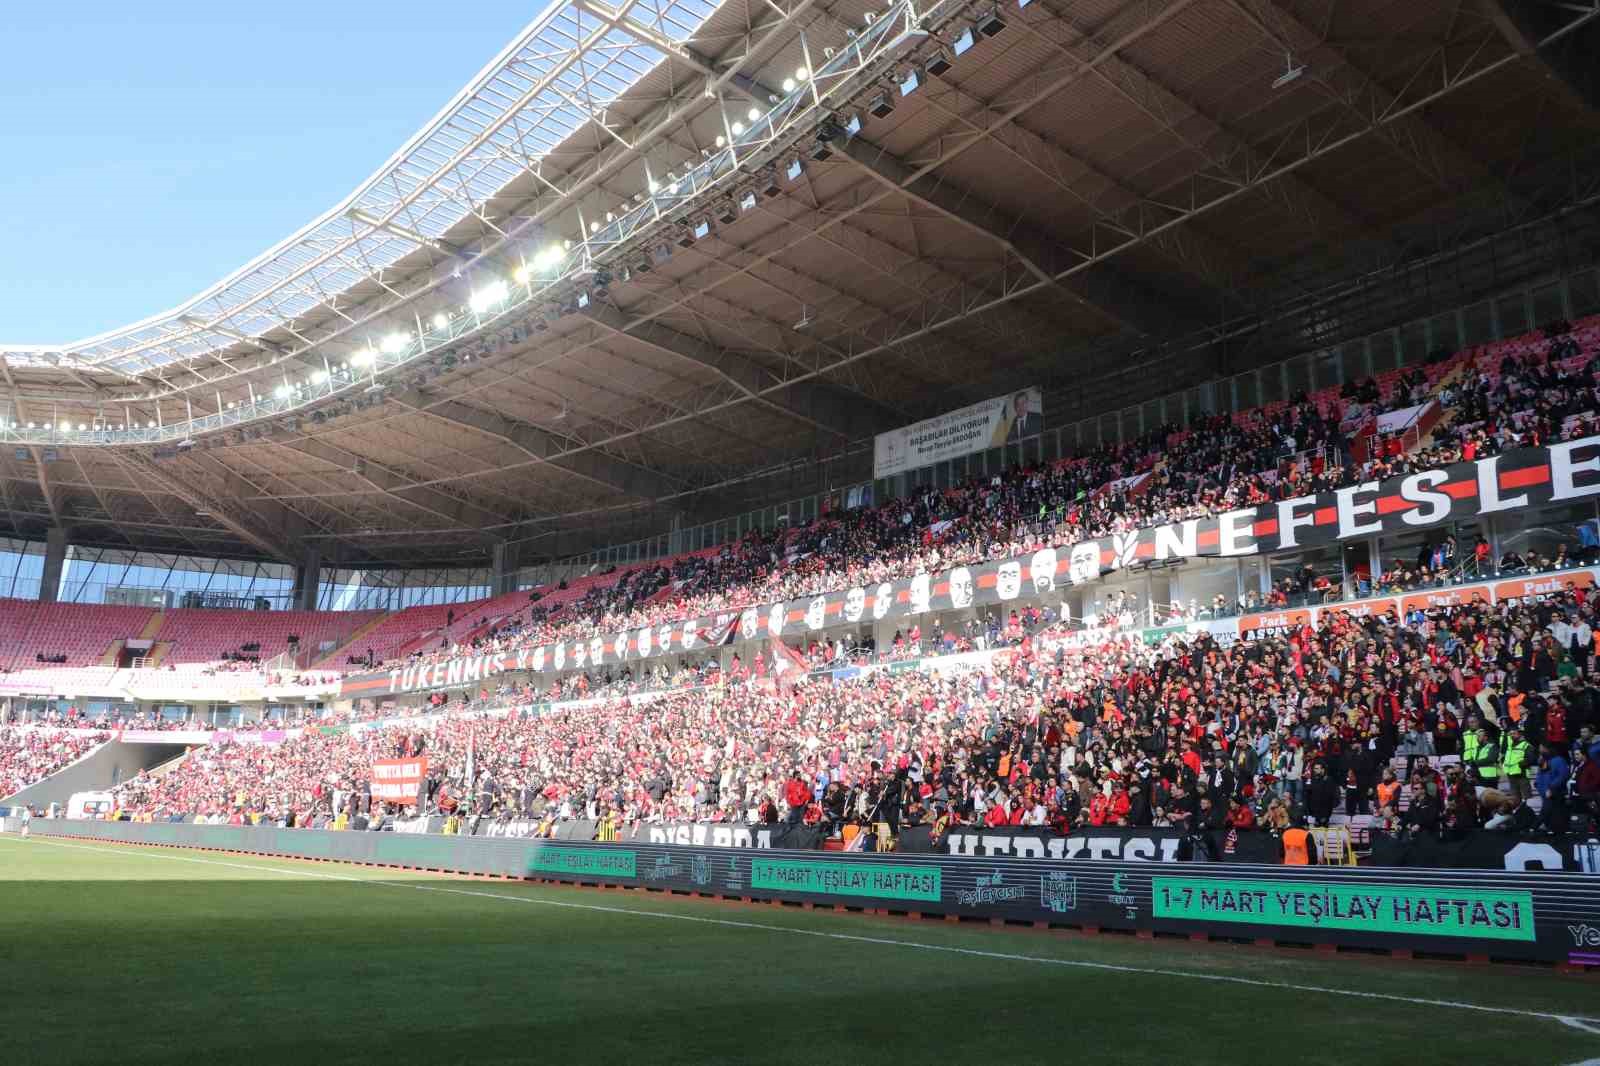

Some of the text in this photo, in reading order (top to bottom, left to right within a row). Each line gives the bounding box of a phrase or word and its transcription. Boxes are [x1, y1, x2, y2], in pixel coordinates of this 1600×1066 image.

[1524, 580, 1562, 597] Park
[757, 866, 773, 881] 1-7
[776, 868, 812, 883] MART
[873, 872, 935, 893] HAFTASI
[1161, 886, 1521, 929] 1-7 MART YEŞİLAY HAFTASI
